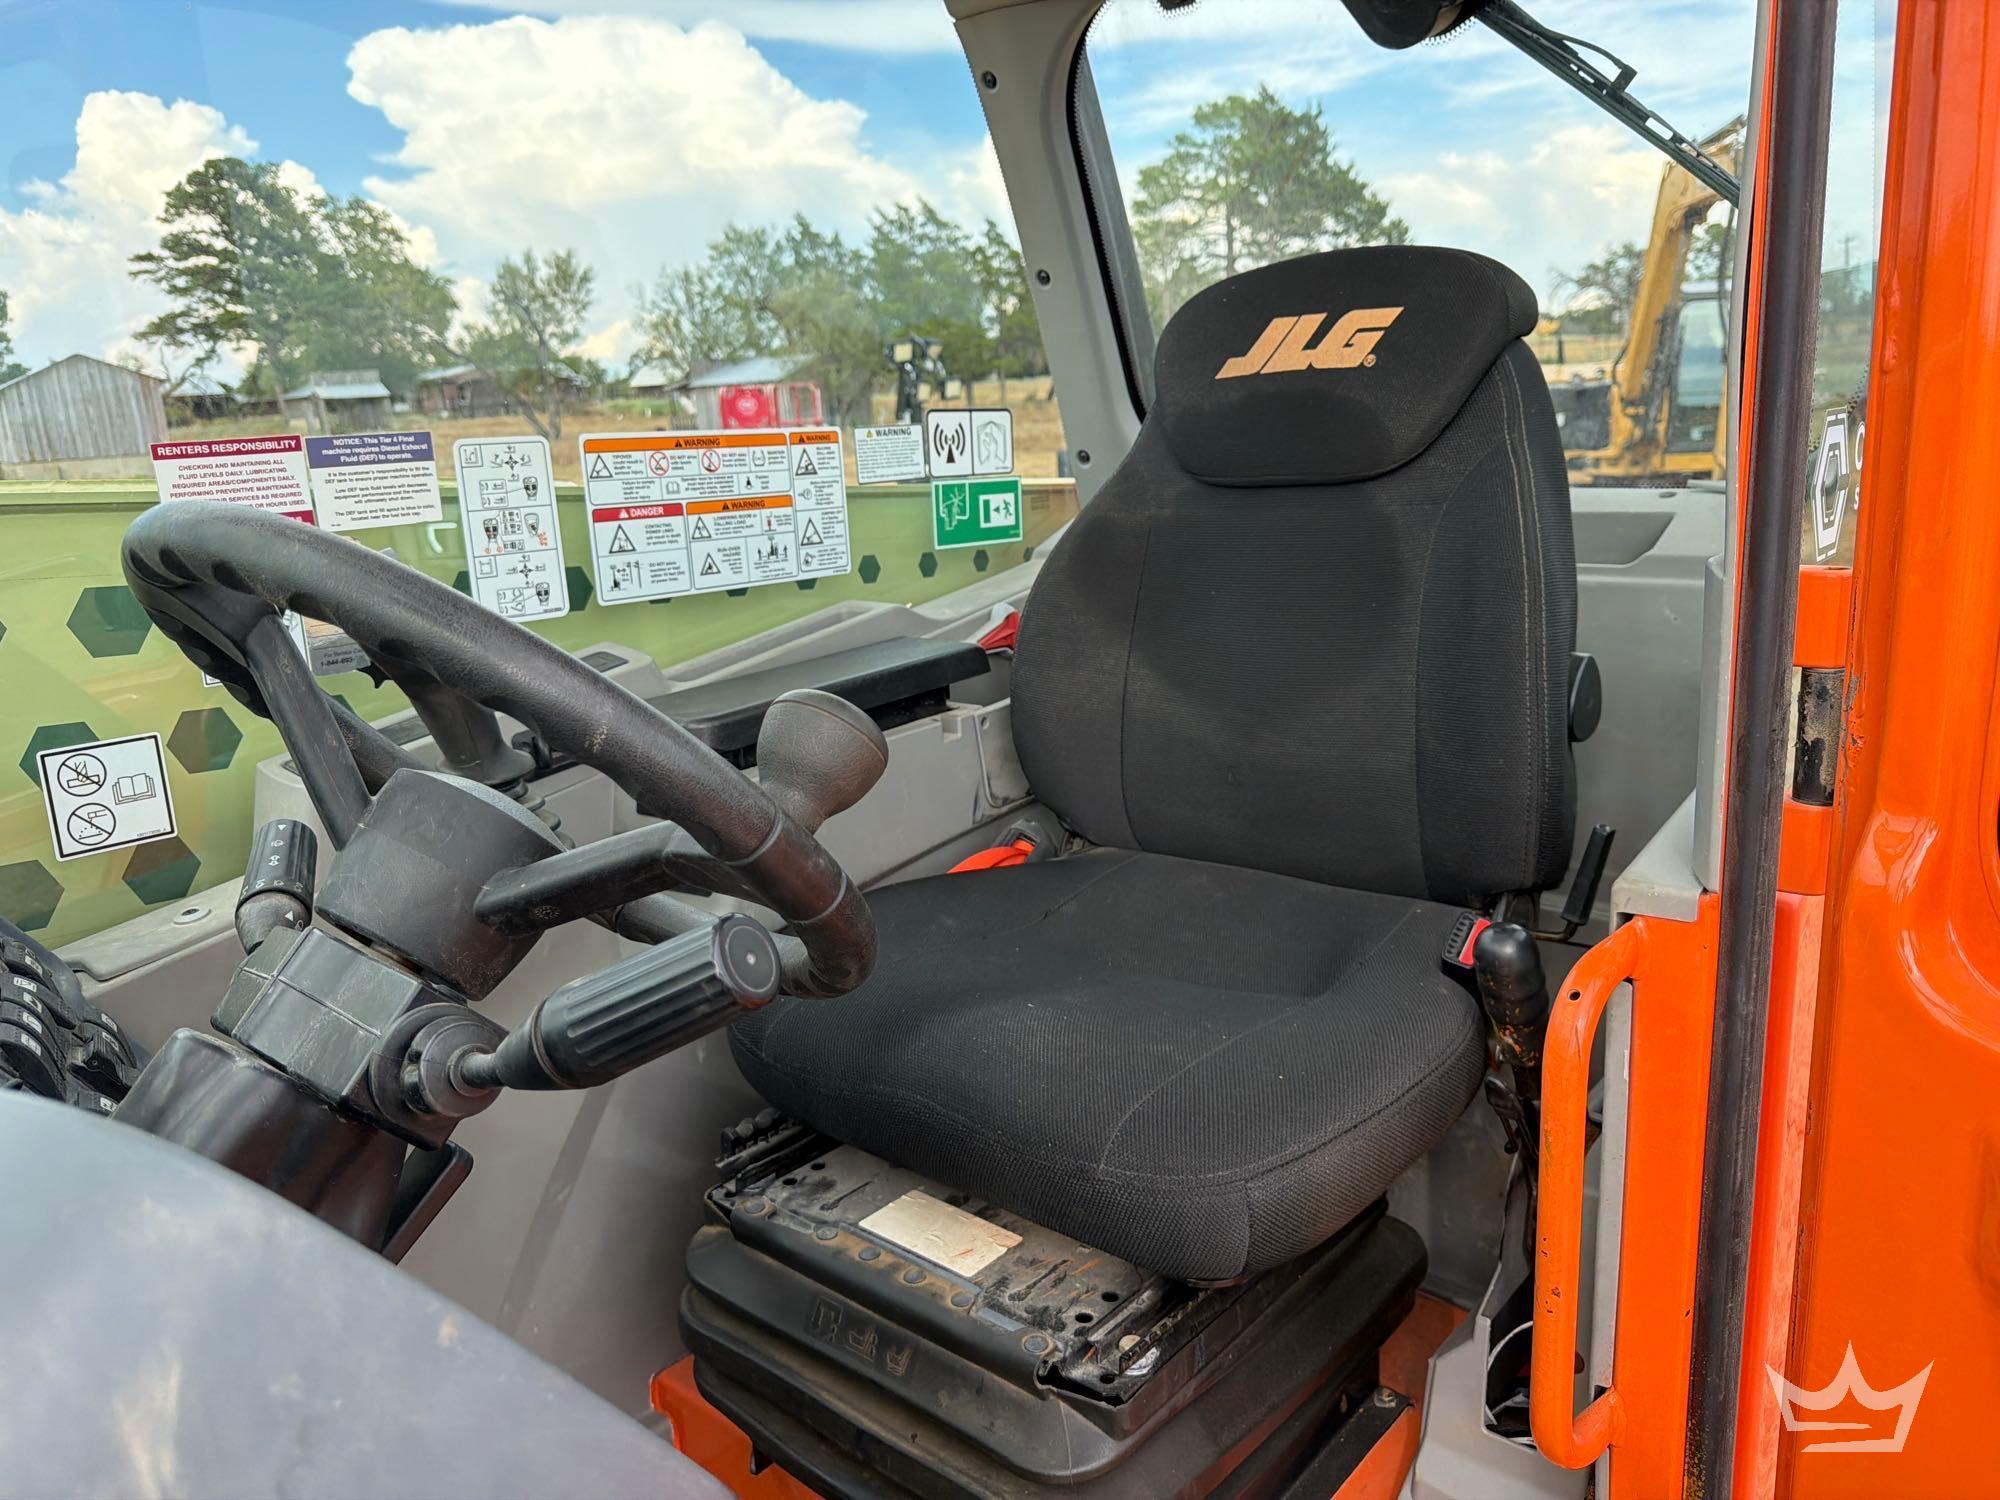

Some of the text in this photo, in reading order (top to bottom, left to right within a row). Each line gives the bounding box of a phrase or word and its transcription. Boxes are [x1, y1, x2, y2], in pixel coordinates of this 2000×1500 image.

[1214, 306, 1405, 380] JLG
[876, 427, 911, 437] WARNING
[684, 438, 720, 447] WARNING
[157, 440, 296, 456] RENTERS RESPONSIBILITY
[359, 454, 378, 462] (DEF)
[208, 477, 276, 487] AREAS/COMPONENTS
[731, 500, 766, 509] WARNING
[630, 506, 664, 517] DANGER
